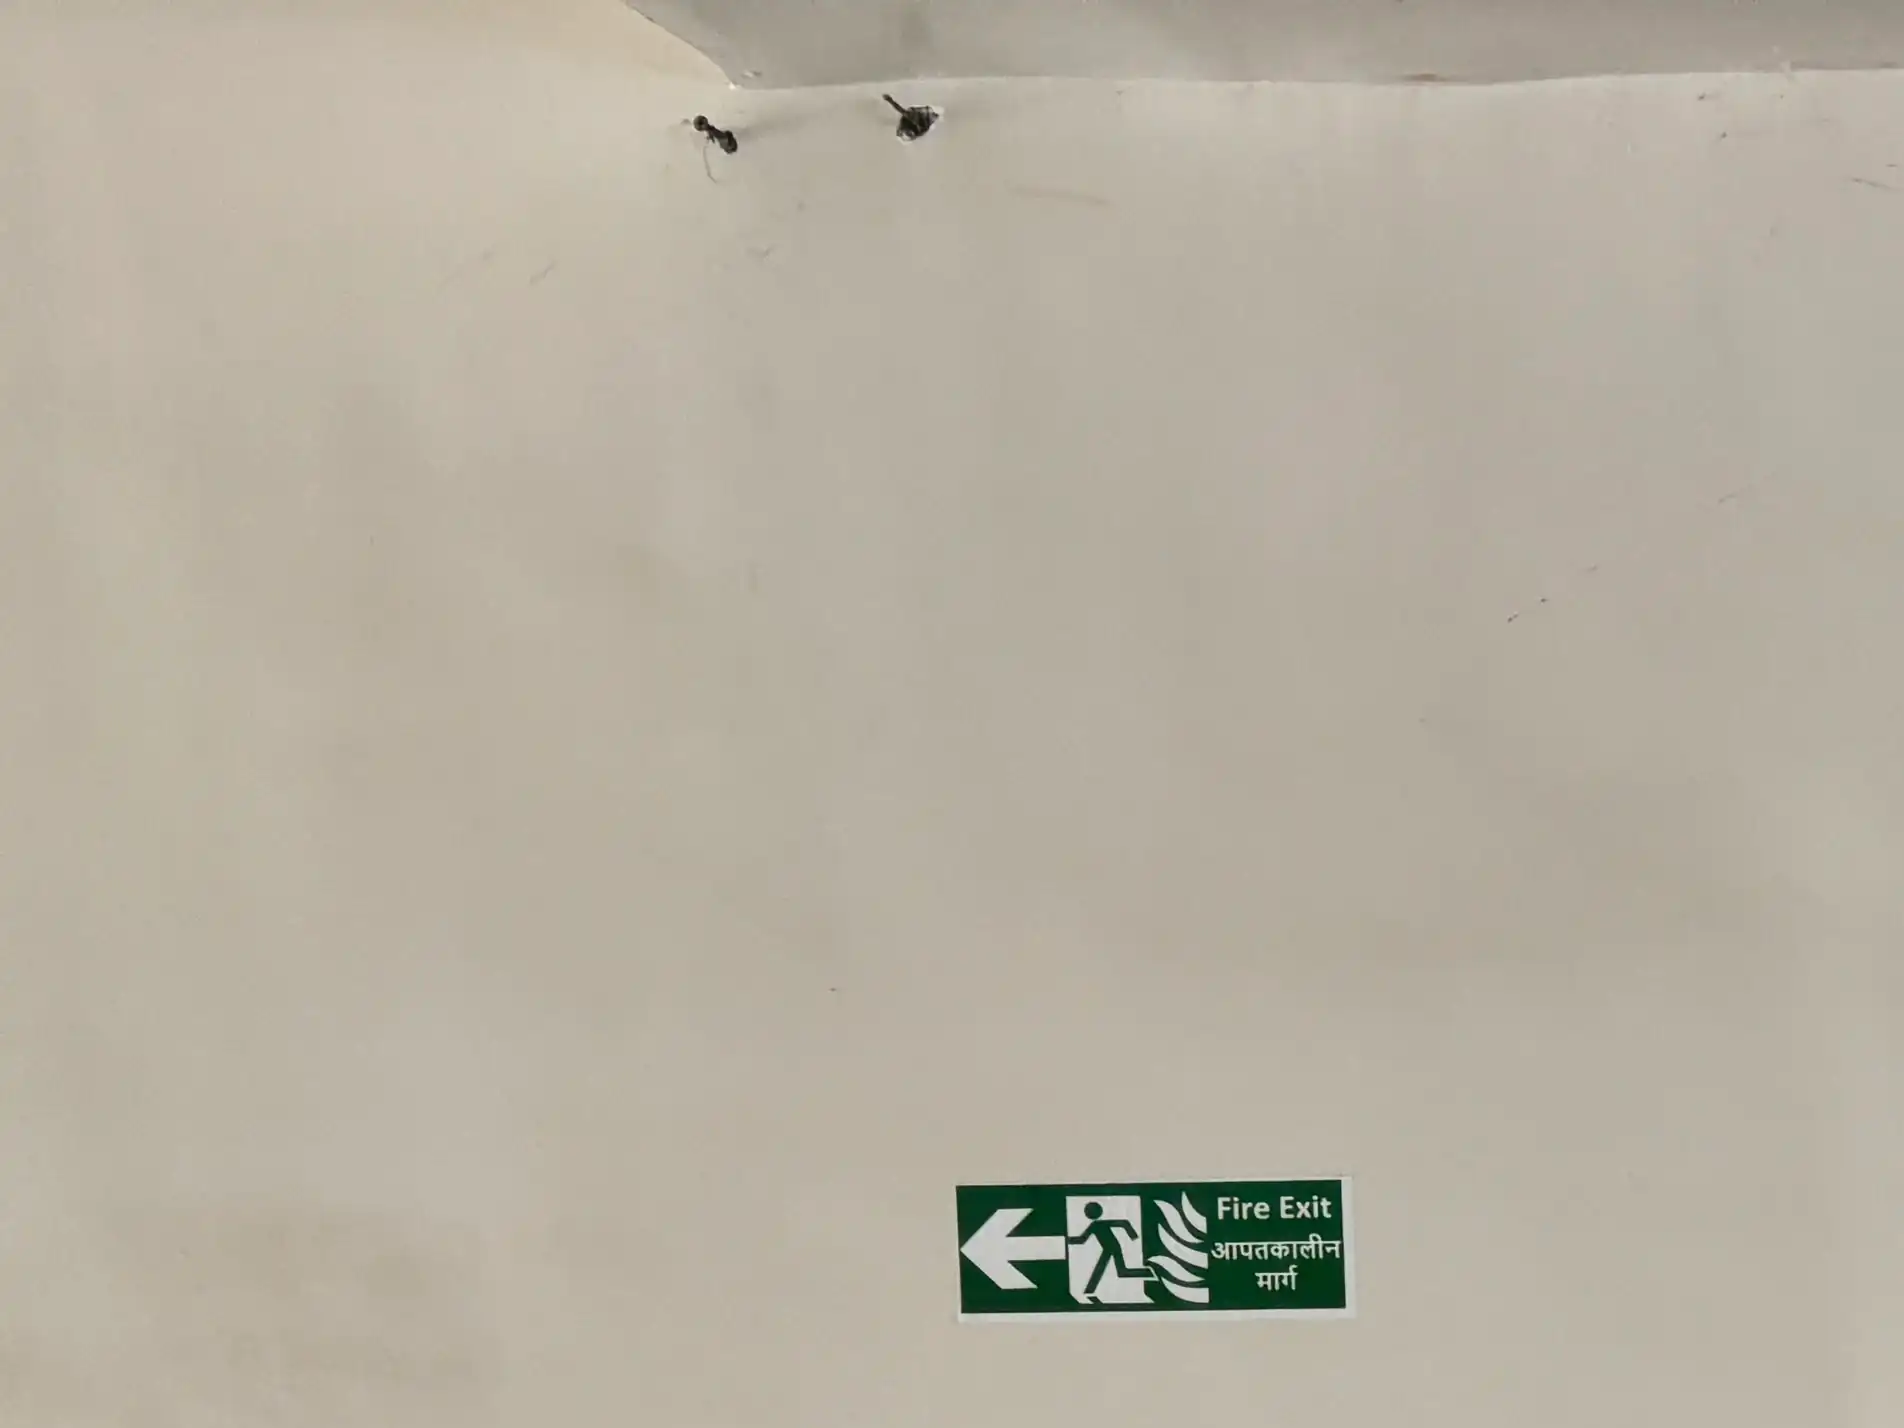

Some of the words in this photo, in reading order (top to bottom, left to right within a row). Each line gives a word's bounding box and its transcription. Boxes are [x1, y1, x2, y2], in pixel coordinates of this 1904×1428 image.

[1217, 1196, 1270, 1220] Fire
[1280, 1195, 1332, 1219] Exit
[1210, 1233, 1341, 1260] आपतकालीन
[1254, 1264, 1298, 1291] मार्ग
